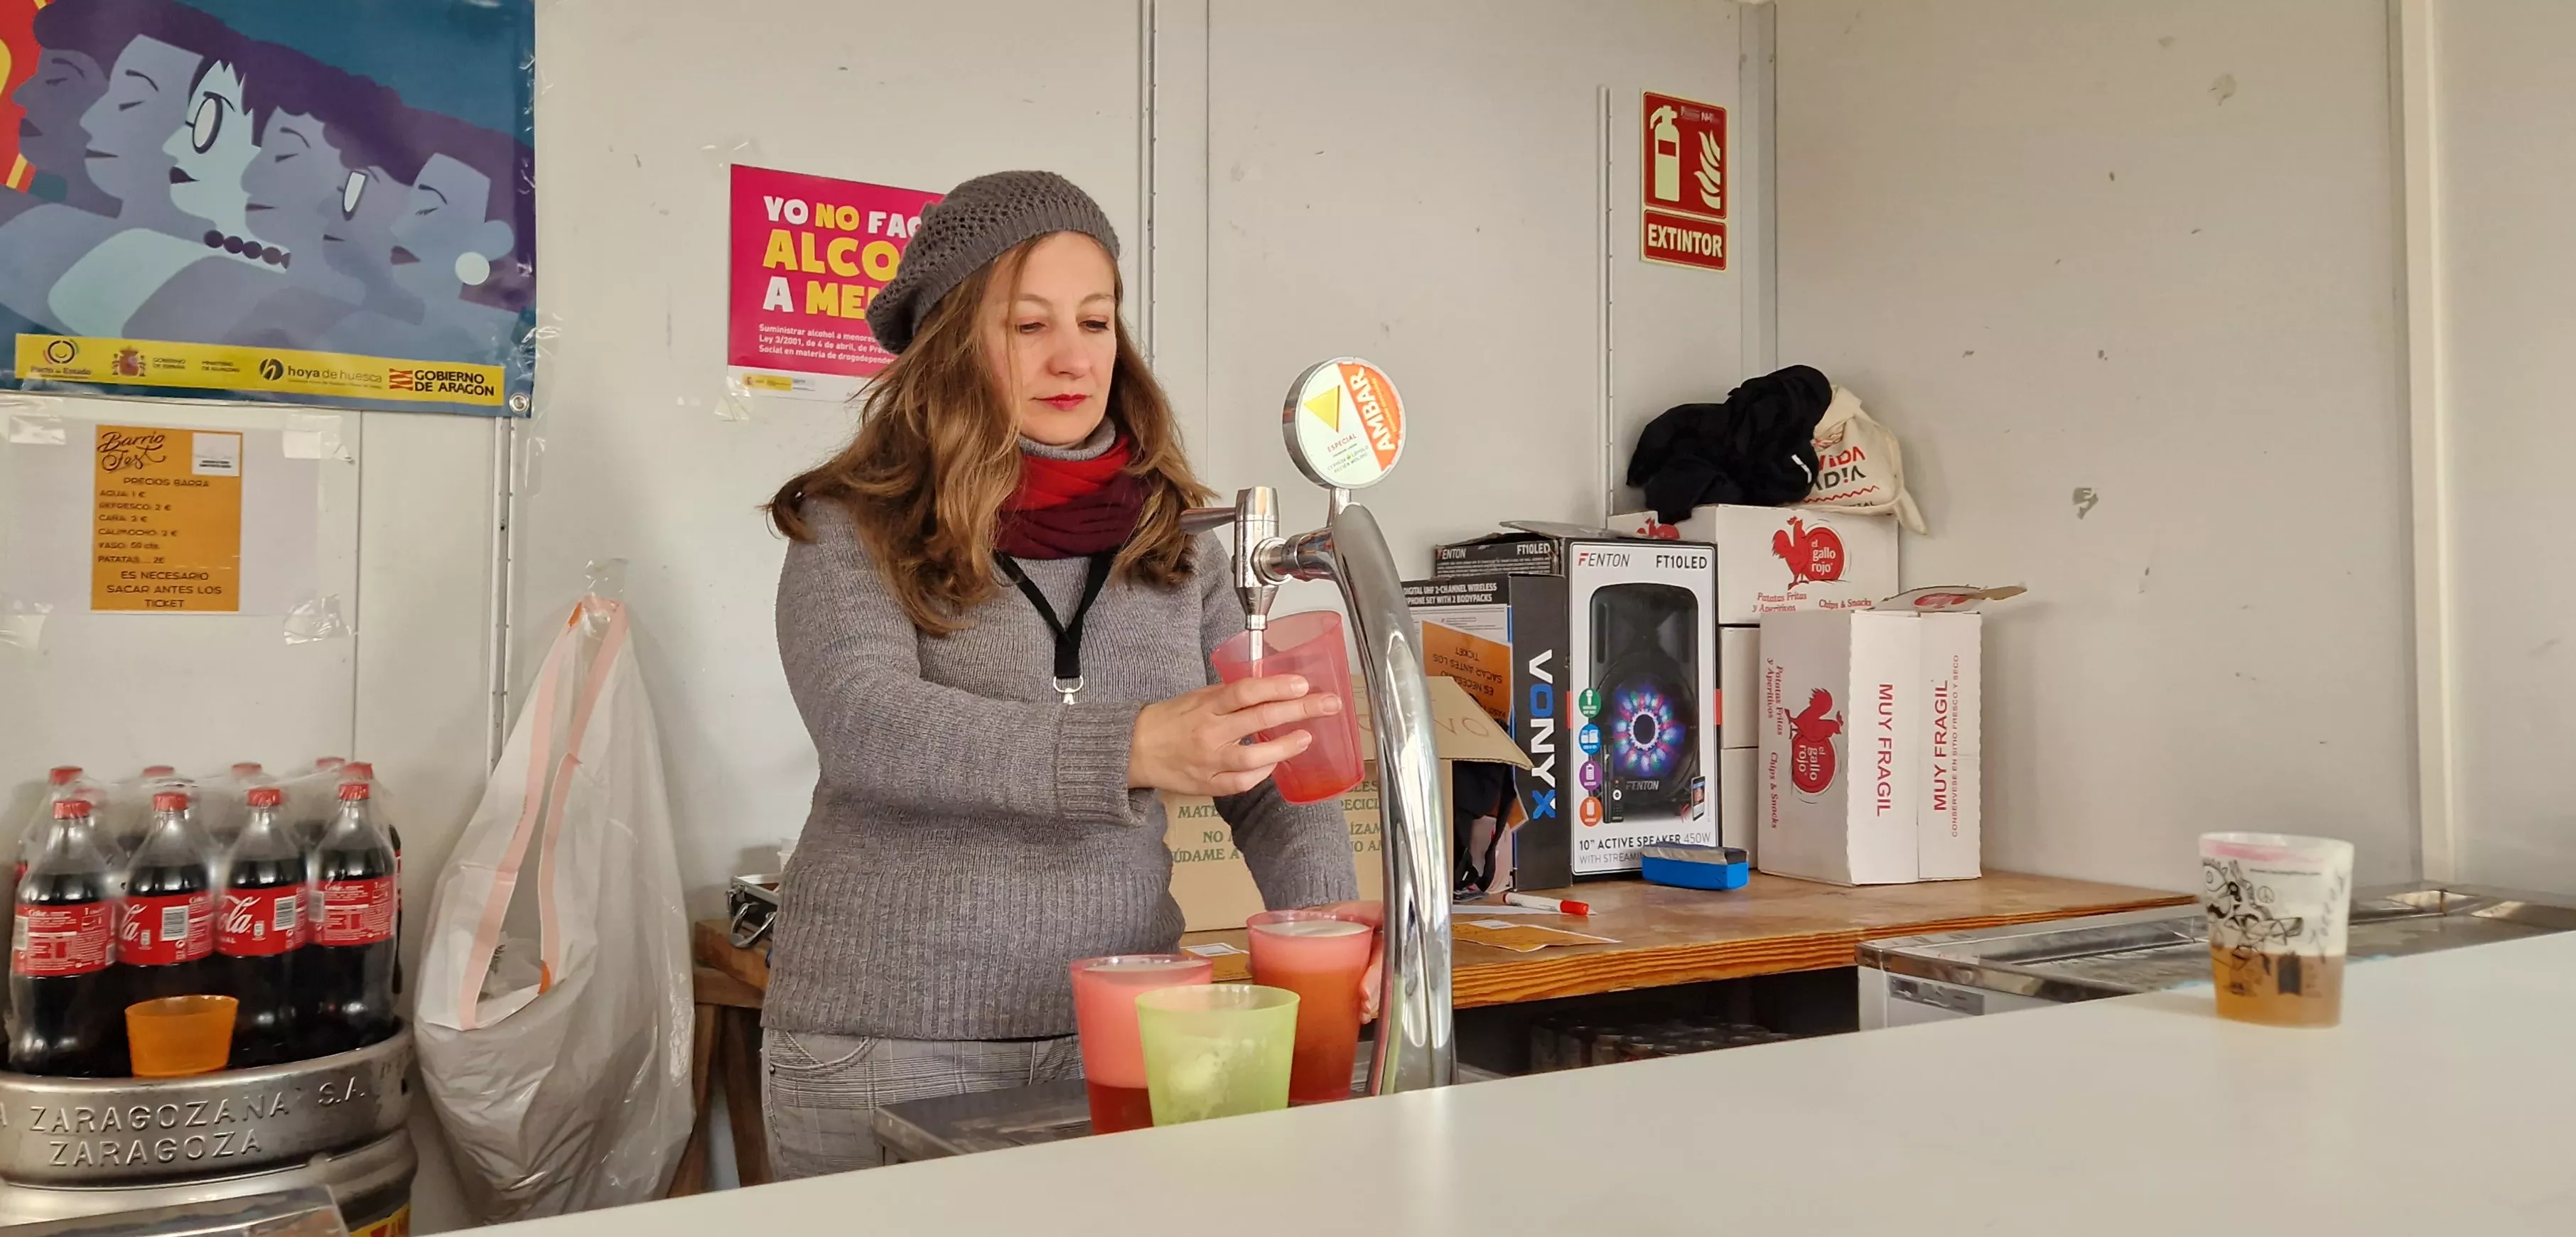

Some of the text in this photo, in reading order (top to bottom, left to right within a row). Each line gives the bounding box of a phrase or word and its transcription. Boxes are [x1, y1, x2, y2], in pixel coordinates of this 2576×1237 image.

[763, 195, 809, 225] YO
[815, 202, 859, 231] NO
[1648, 223, 1723, 258] EXTINTOR
[762, 229, 900, 281] ALCO
[762, 276, 794, 313] A
[760, 324, 805, 336] Suministrar
[807, 330, 835, 340] alcohol
[759, 335, 773, 345] Ley
[775, 336, 804, 347] 3/2001,
[836, 343, 856, 352] abril,
[759, 345, 782, 355] Social
[796, 349, 825, 359] materia
[288, 366, 382, 384] hoya de huesca
[414, 369, 485, 384] GOBIERNO
[414, 381, 495, 396] DE ARAGON
[1350, 367, 1396, 451] AMBAR
[97, 431, 166, 453] Barrio
[1327, 433, 1357, 453] ESPECIAL
[124, 477, 210, 487] PRECIOS BARRA
[1517, 543, 1551, 555] FT10LED
[1812, 539, 1818, 548] el
[1578, 553, 1708, 569] FENTON FT10LED
[1813, 547, 1836, 561] gallo
[141, 571, 209, 580] NECESARIO
[1811, 562, 1831, 576] rojo
[107, 585, 149, 593] SACAR
[198, 586, 222, 595] LOS
[1424, 586, 1434, 595] UHF
[1435, 584, 1467, 594] 2-CHANNEL
[1468, 583, 1497, 592] WIRELESS
[144, 599, 185, 607] TICKET
[1457, 593, 1492, 603] BODYPACKS
[1757, 592, 1807, 602] Patatas Fritas
[1819, 599, 1838, 609] Chips
[1848, 598, 1872, 607] Snacks
[1455, 646, 1480, 661] TICKET
[1433, 654, 1502, 684] SACAR ANTES LOS
[1484, 686, 1494, 696] ES
[1766, 667, 1774, 718] Aperitivos
[1775, 665, 1784, 706] Patatas
[1529, 649, 1556, 819] VONYX
[1818, 747, 1826, 755] el
[1877, 684, 1893, 817] MUY FRAGIL
[1934, 680, 1948, 811] MUY FRAGIL
[1768, 752, 1778, 780] Chips
[1796, 745, 1808, 773] rojo
[1808, 747, 1821, 781] gallo
[1952, 759, 1958, 772] EN
[1626, 780, 1659, 790] FENTON
[1203, 831, 1223, 843] NO
[1597, 837, 1634, 850] ACTIVE
[1684, 833, 1711, 844] 450W
[1173, 848, 1225, 863] ÚDAME
[1580, 855, 1601, 864] WITH
[30, 1091, 289, 1132] ZARAGOZANA
[49, 1128, 262, 1167] ZARAGOZA
